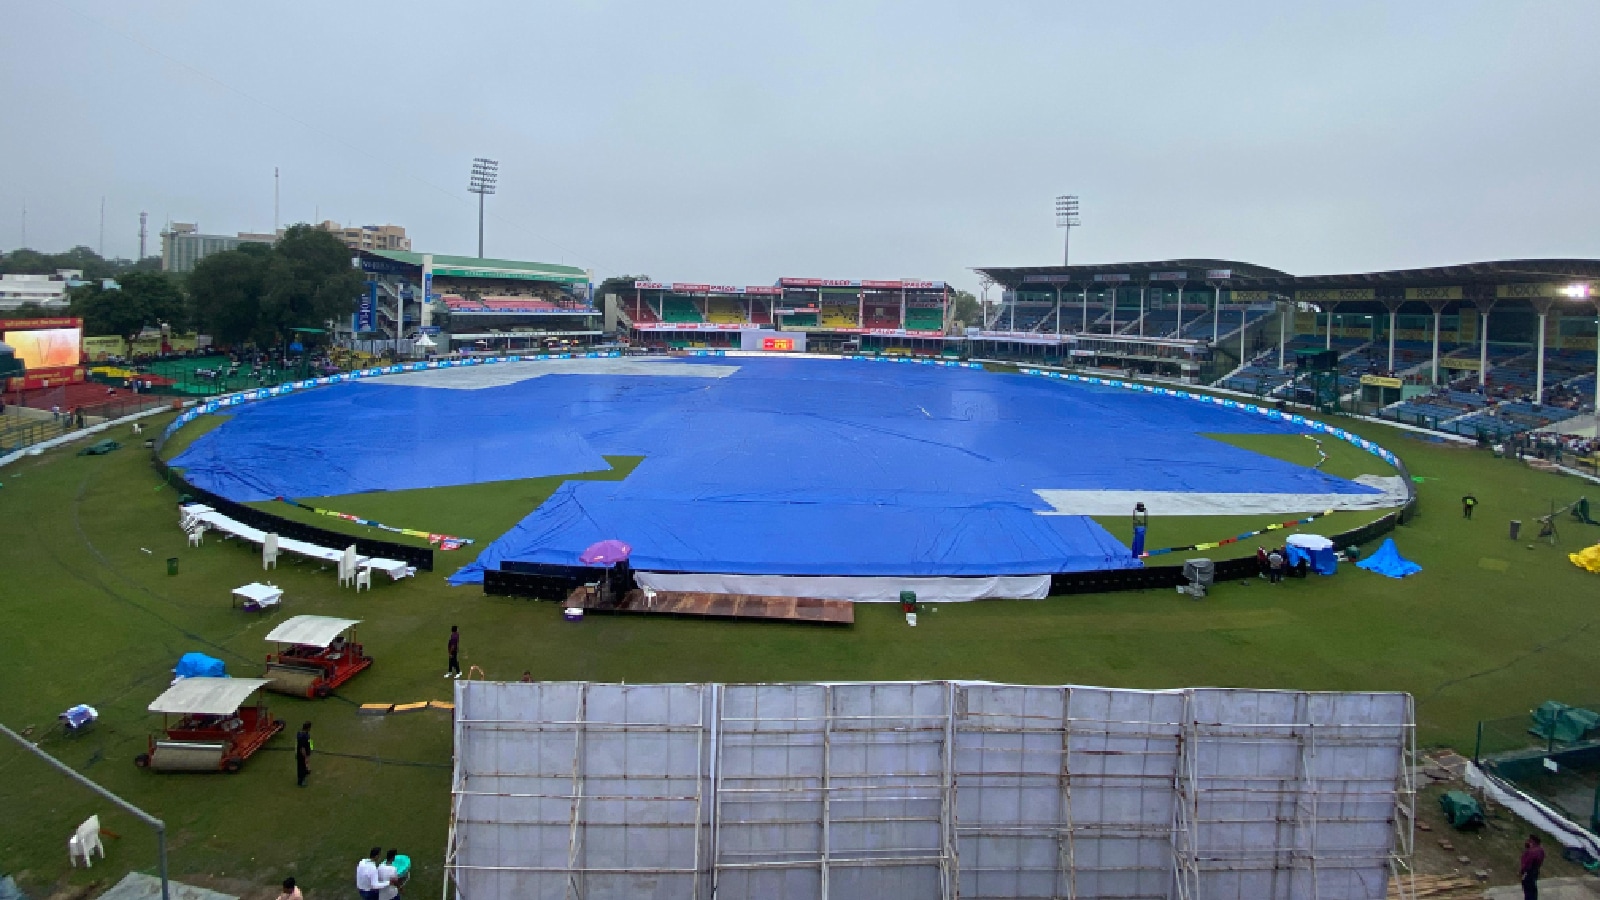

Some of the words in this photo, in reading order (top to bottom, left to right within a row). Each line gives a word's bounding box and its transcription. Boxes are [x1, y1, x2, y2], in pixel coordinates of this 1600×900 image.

[1299, 290, 1329, 300] ROXX
[1339, 289, 1369, 299] ROXX
[1416, 287, 1450, 298] ROXX
